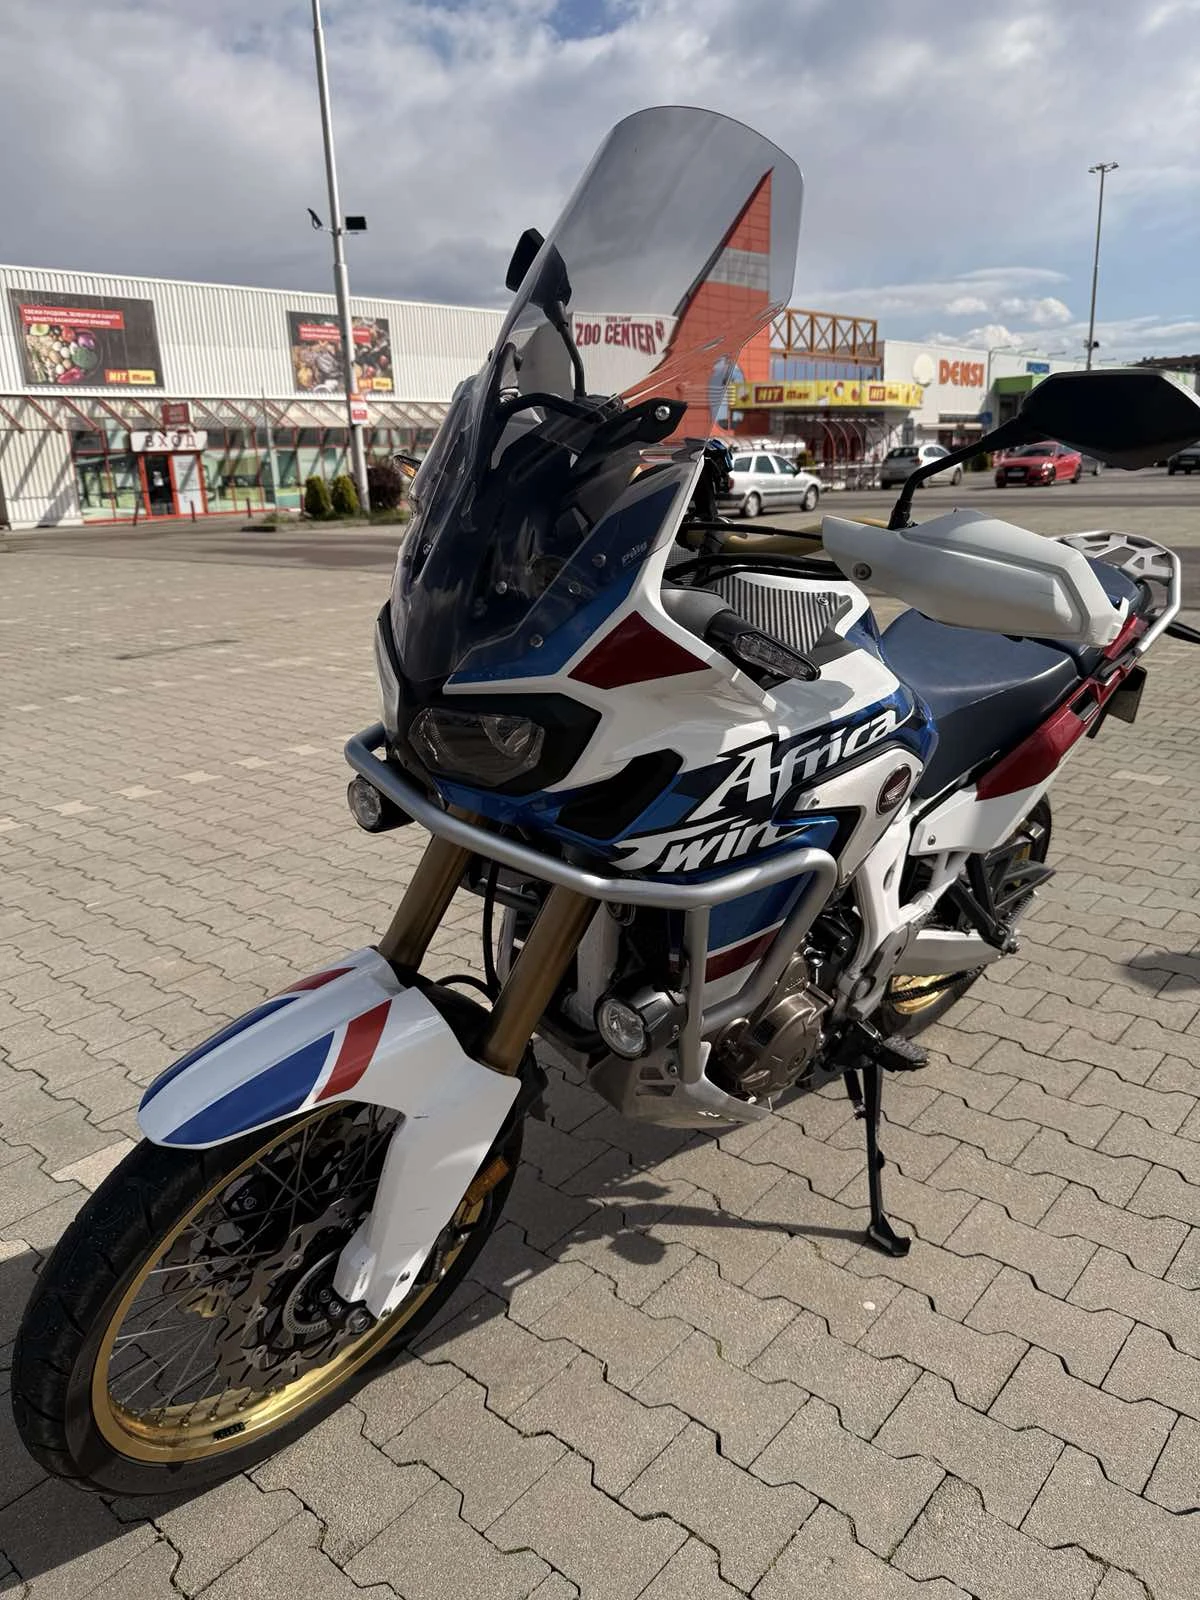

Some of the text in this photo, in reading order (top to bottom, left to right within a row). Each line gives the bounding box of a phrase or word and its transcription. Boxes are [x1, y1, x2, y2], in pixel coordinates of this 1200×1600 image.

[576, 322, 656, 355] ZOO CENTER
[109, 371, 128, 381] HIT
[758, 388, 781, 401] HIT
[871, 388, 884, 400] HIT
[685, 704, 914, 823] Africa
[609, 814, 810, 873] Twin
